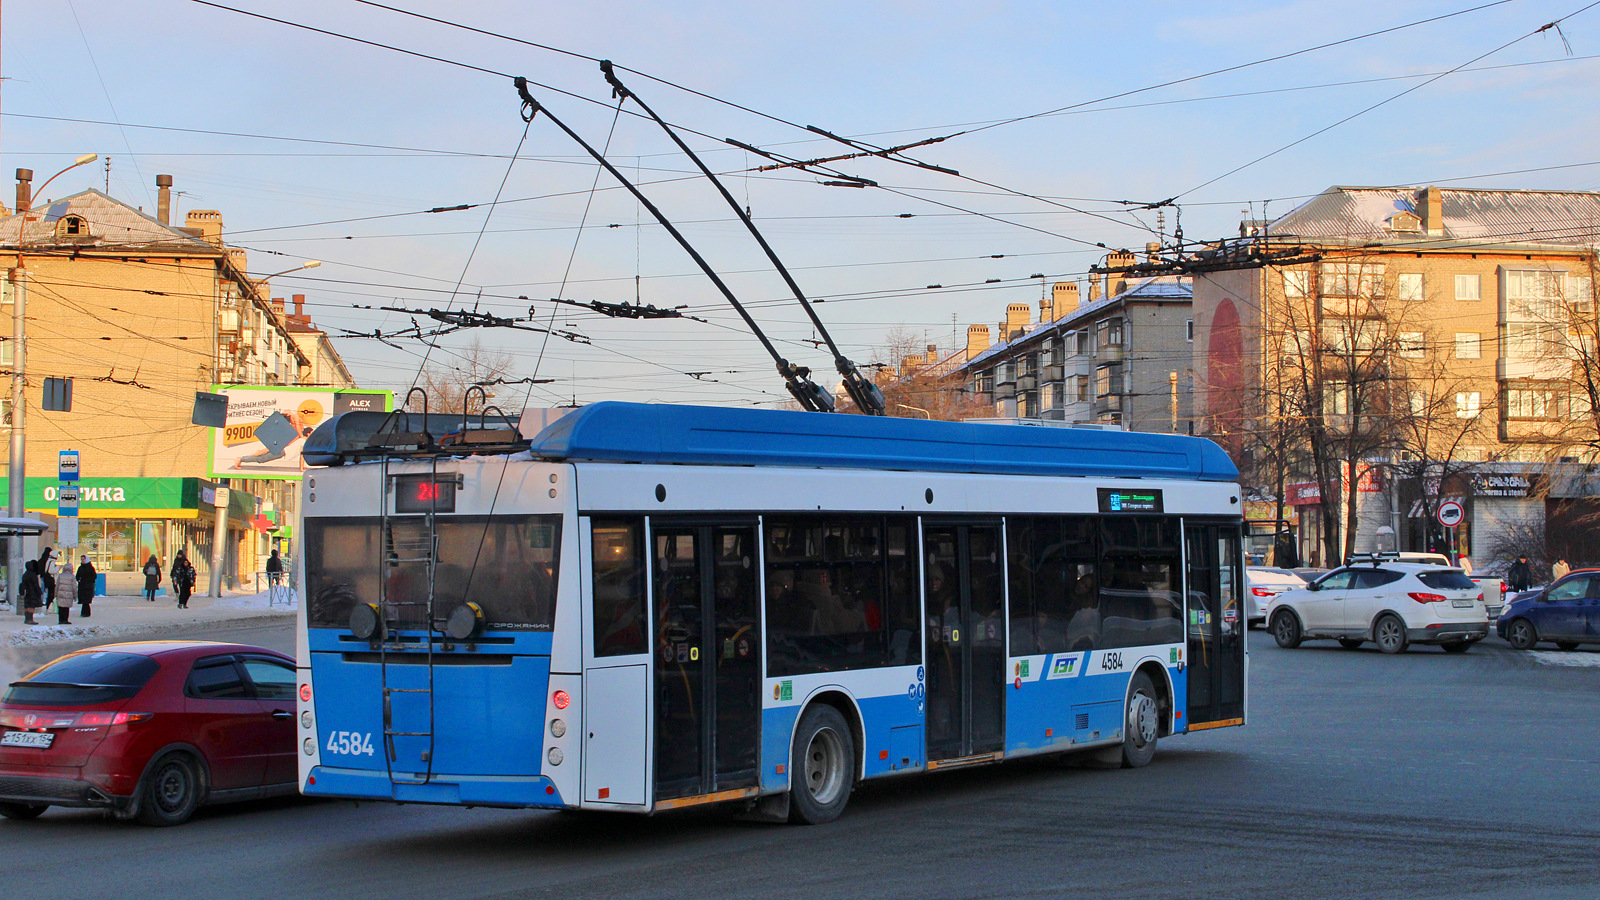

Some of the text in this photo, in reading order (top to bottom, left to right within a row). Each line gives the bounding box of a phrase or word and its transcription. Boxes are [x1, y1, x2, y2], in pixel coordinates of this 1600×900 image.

[349, 399, 371, 407] ALEX
[226, 410, 246, 418] ИТНЕС
[226, 425, 252, 440] 9900
[43, 486, 126, 502] оика
[487, 622, 550, 630] ГОРОЖАНИН
[1101, 652, 1123, 671] 4584
[326, 730, 375, 757] 4584
